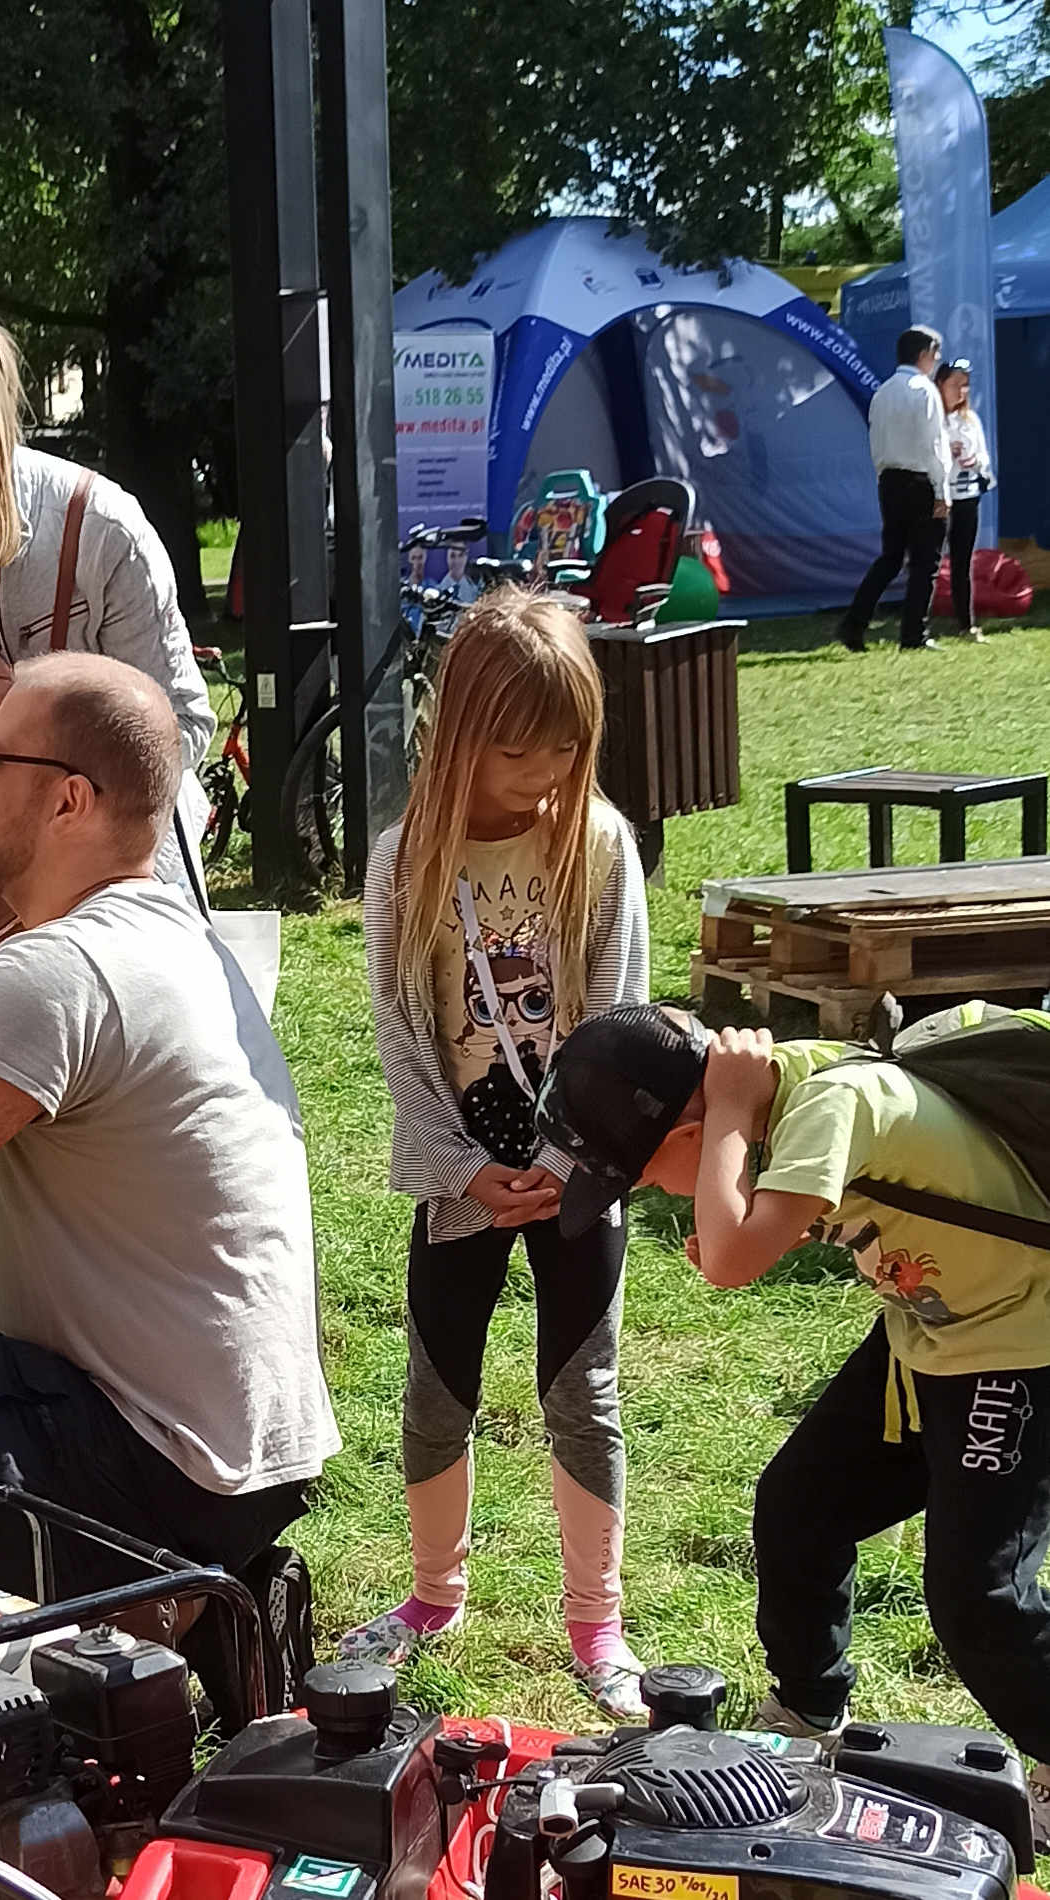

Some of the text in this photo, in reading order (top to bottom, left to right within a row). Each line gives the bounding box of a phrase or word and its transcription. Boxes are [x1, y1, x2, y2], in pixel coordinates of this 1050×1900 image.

[404, 352, 484, 368] MEDITA
[415, 388, 439, 406] 518
[445, 387, 461, 406] 26
[466, 387, 484, 405] 55
[962, 1378, 1017, 1471] SKATE
[618, 1873, 651, 1893] SAE
